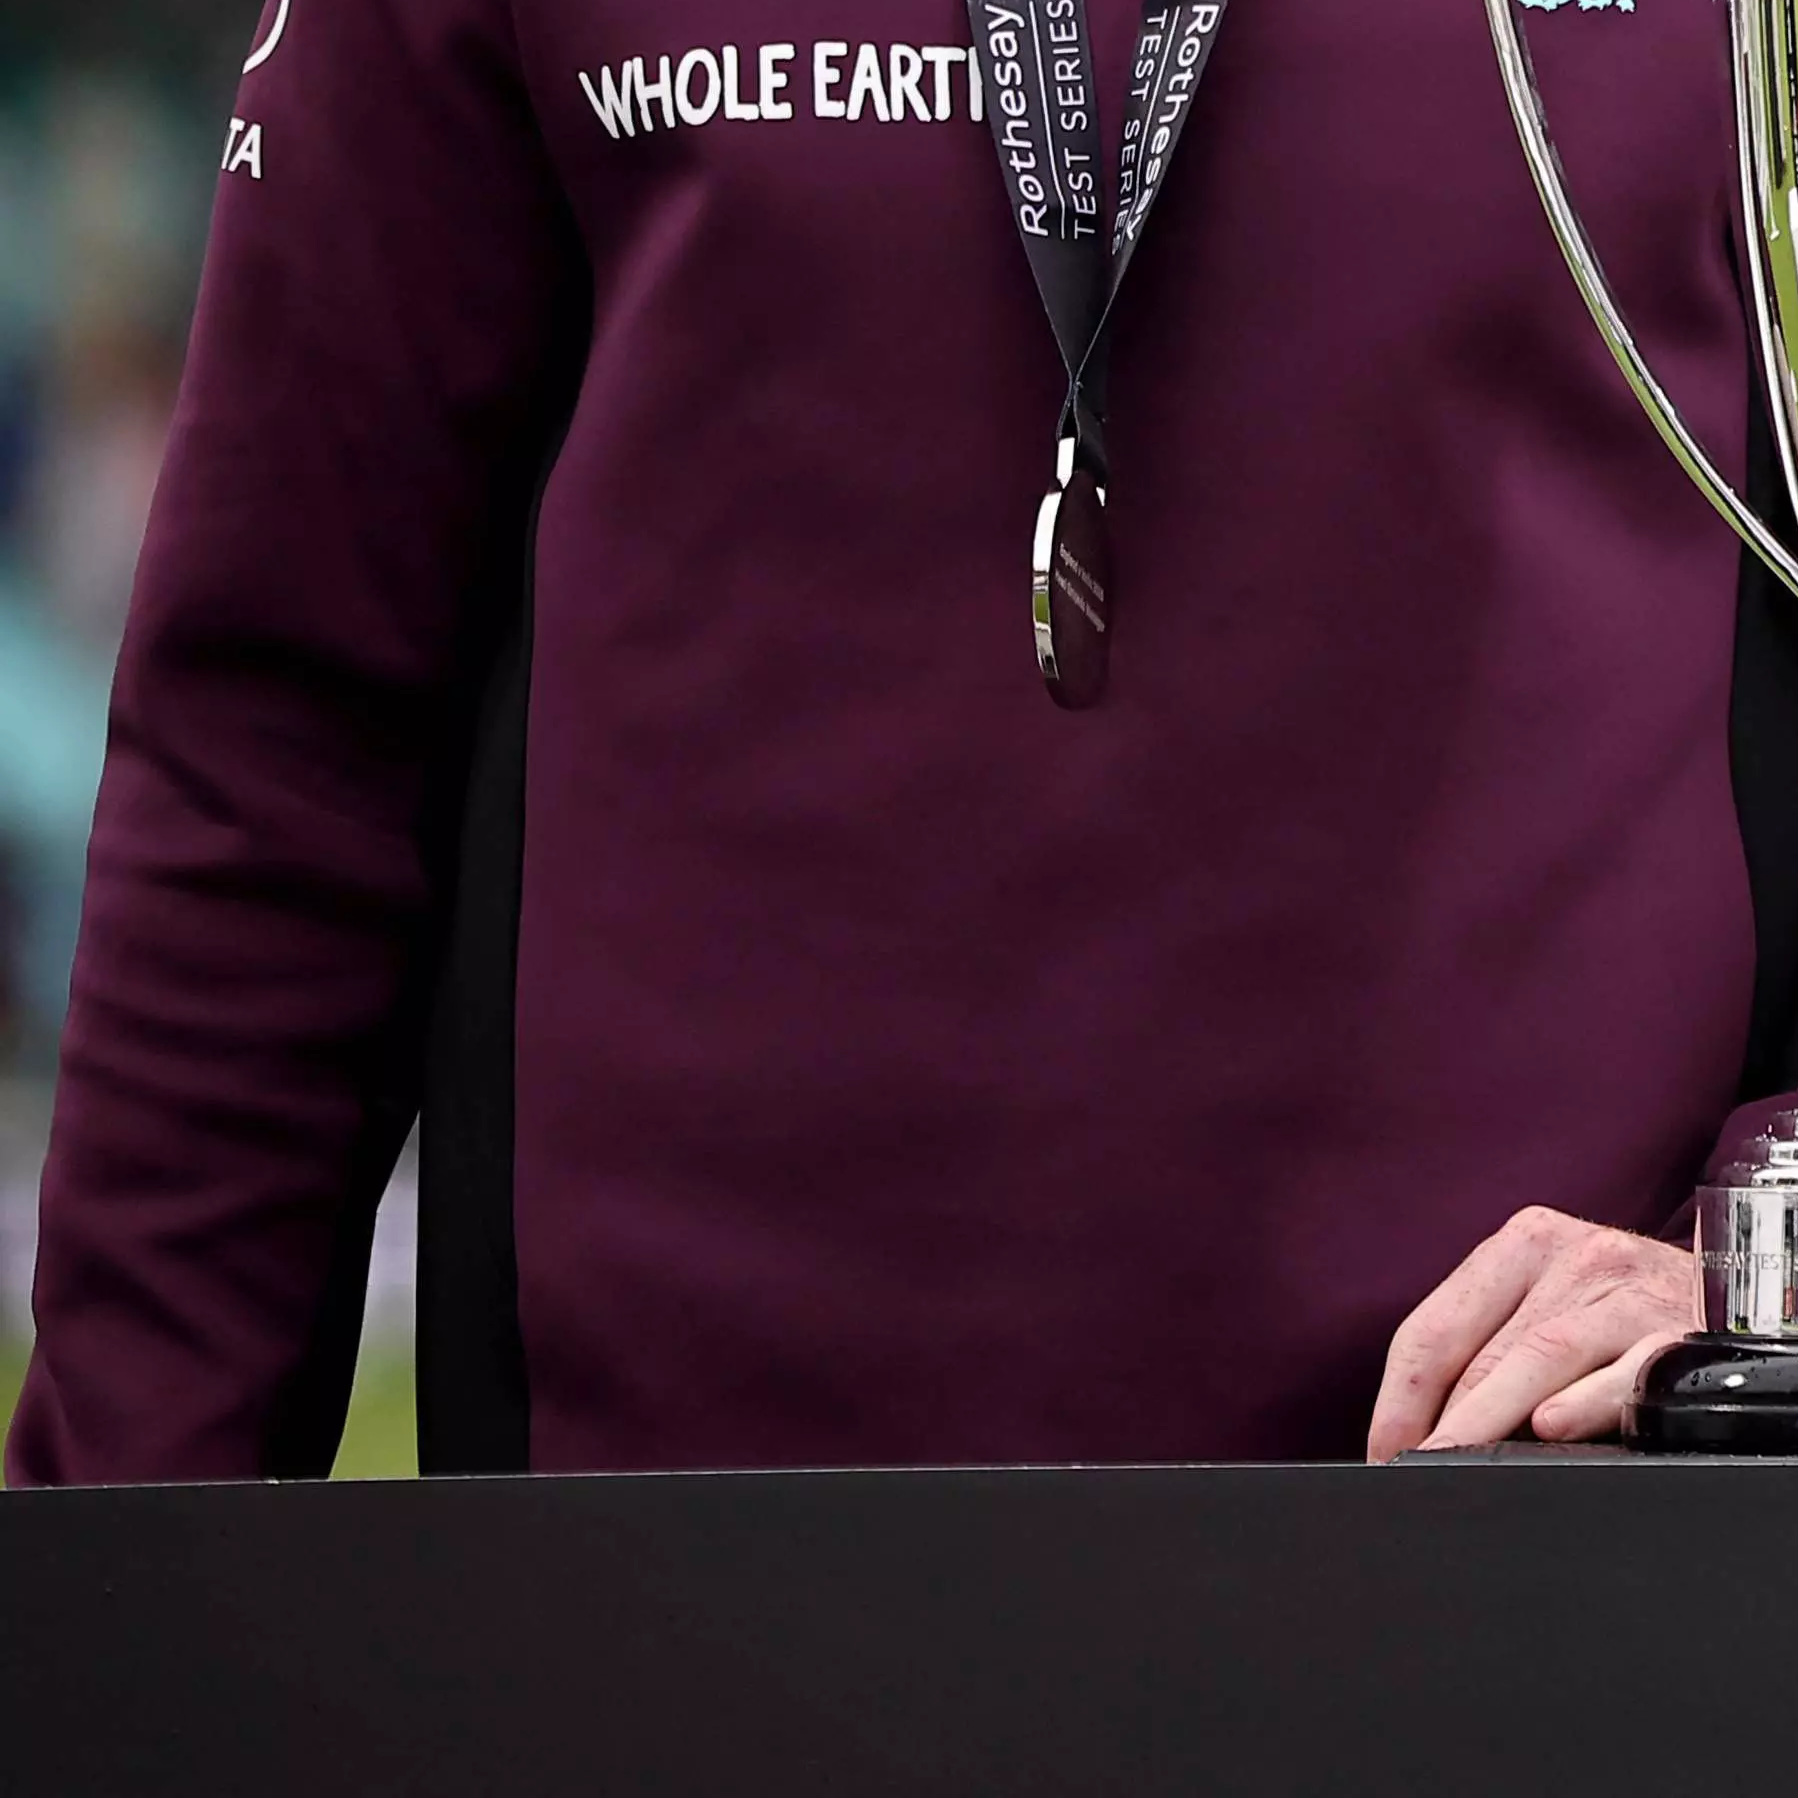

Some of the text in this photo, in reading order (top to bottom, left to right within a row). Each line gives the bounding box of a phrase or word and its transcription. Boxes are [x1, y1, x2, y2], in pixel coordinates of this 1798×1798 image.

[578, 43, 796, 140] WHOLE
[1131, 8, 1168, 101] TEST
[984, 3, 1049, 237] Rothesay
[1126, 4, 1220, 242] Rothesay
[1064, 147, 1097, 239] TEST
